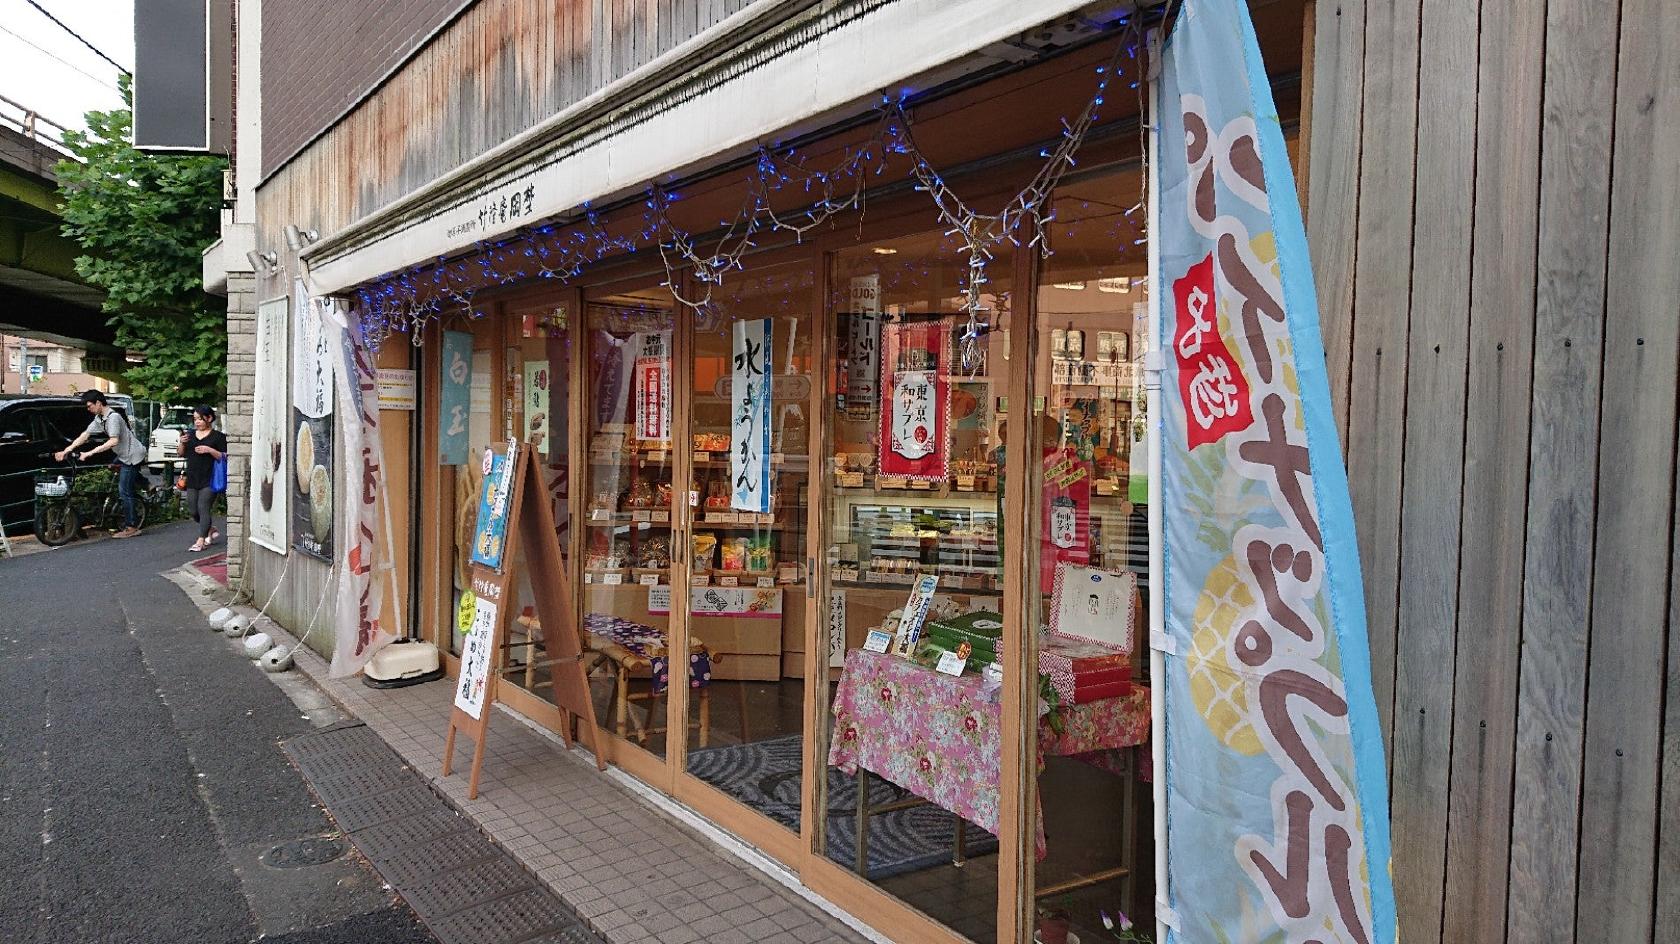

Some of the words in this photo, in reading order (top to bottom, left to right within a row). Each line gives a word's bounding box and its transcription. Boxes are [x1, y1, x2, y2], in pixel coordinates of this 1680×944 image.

[448, 352, 468, 436] 白玉
[735, 338, 763, 493] 水ようかん
[915, 384, 928, 423] 東京
